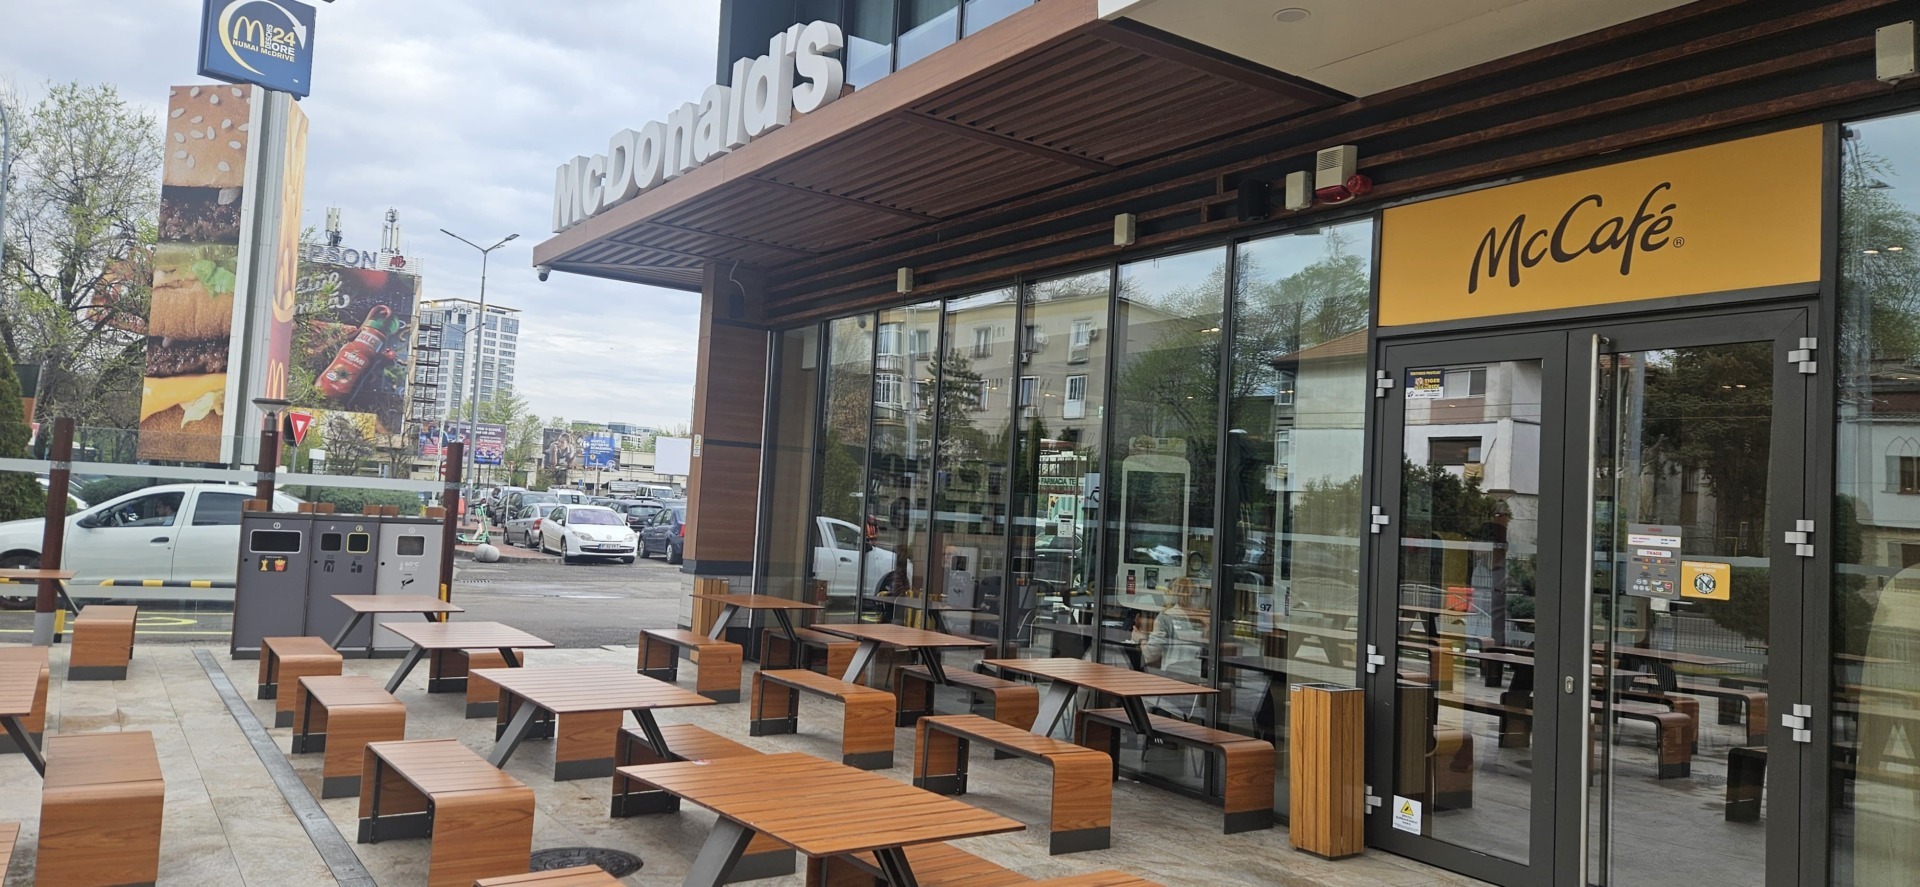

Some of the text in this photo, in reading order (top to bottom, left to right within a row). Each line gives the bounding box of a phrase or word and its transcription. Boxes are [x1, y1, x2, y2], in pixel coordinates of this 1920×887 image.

[272, 27, 296, 47] 24
[232, 39, 295, 62] NUMAI McDRIVE
[271, 42, 295, 56] ORE
[552, 20, 843, 233] McDonald's
[1468, 181, 1677, 294] McCafé
[1041, 477, 1067, 485] FARMACIA
[1259, 603, 1272, 612] 97
